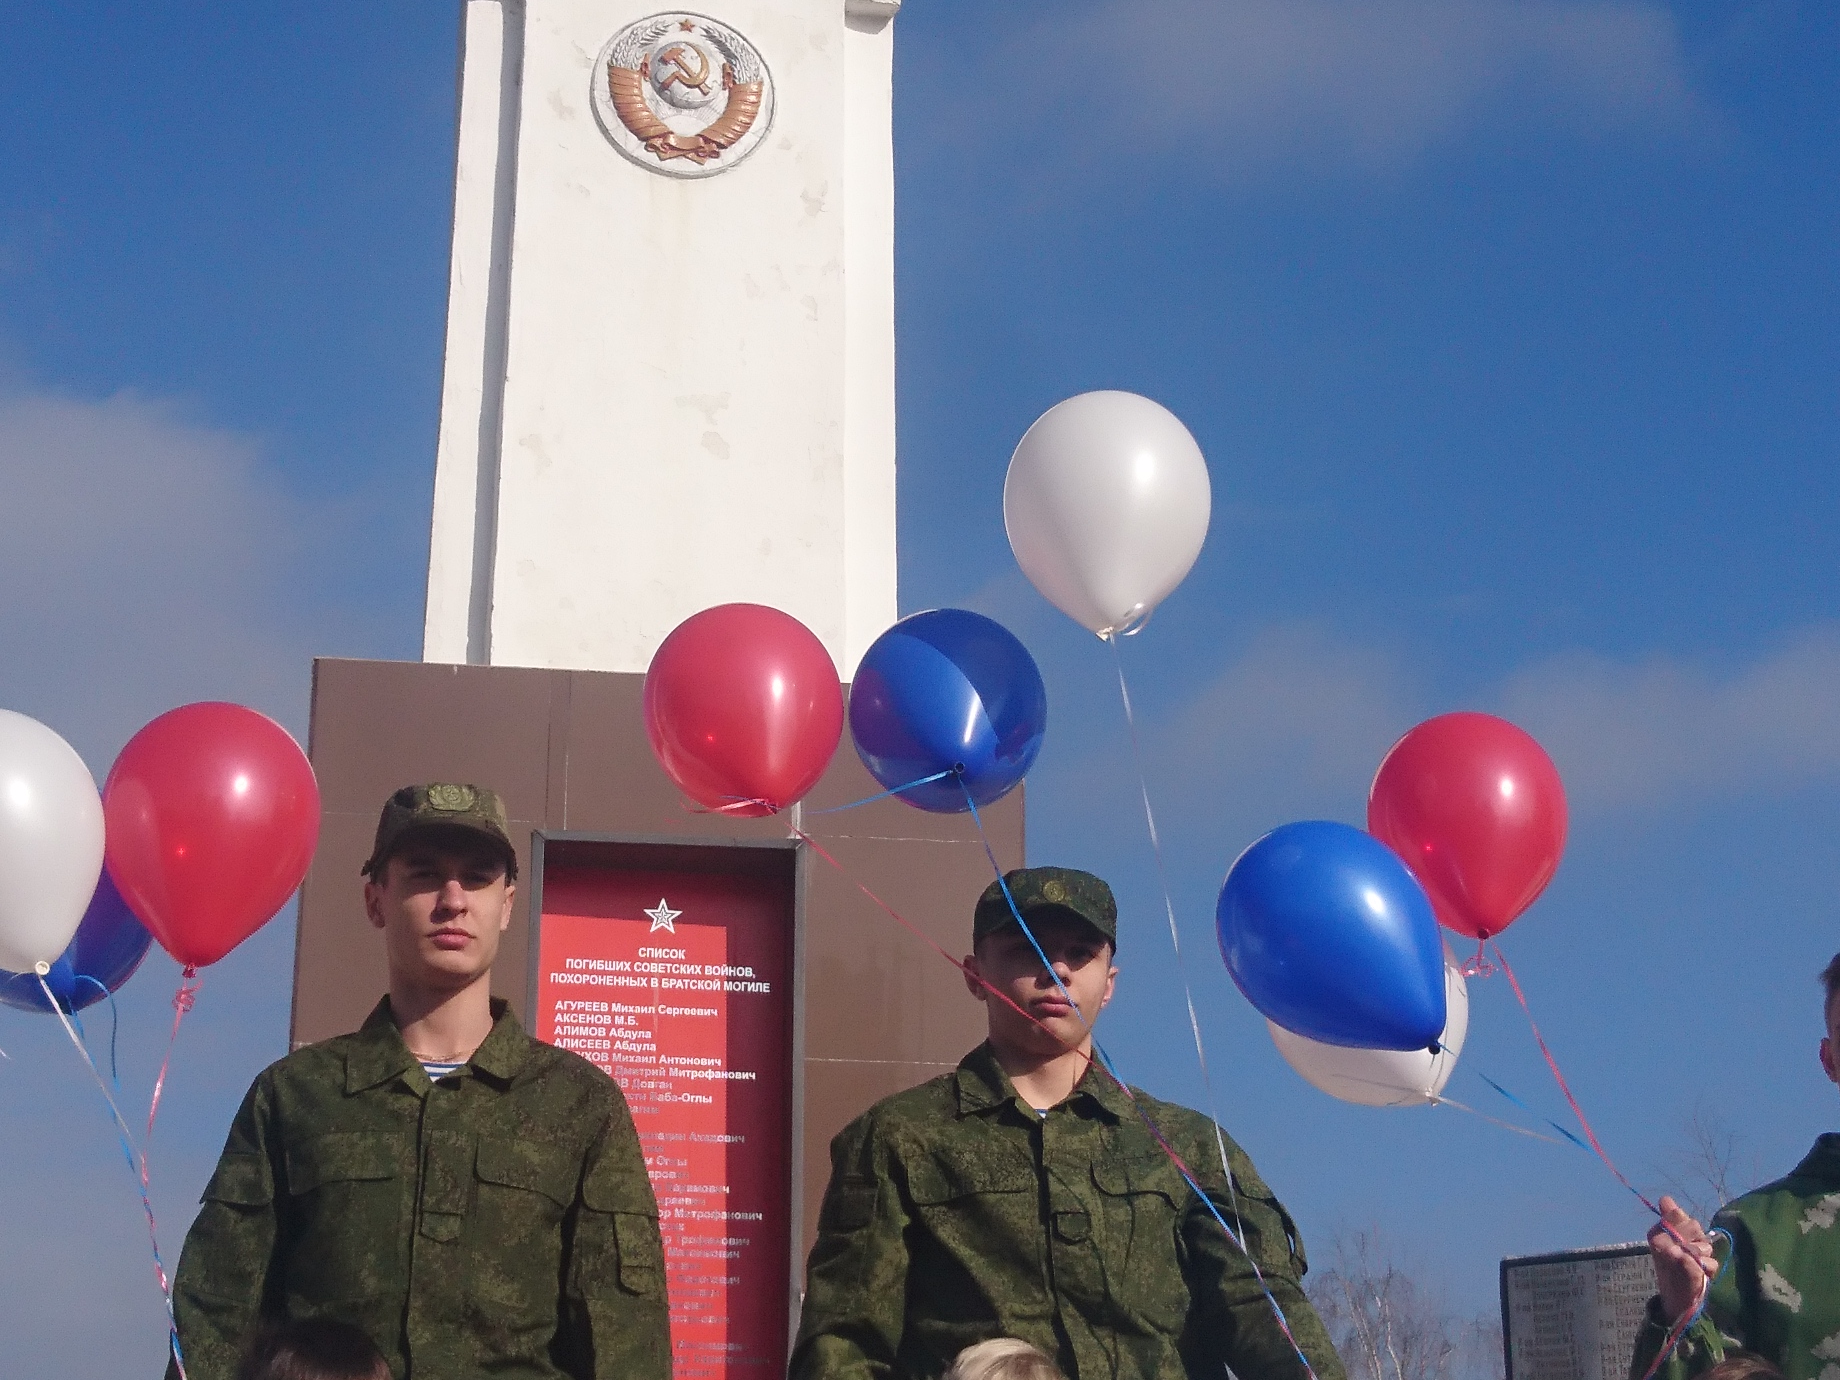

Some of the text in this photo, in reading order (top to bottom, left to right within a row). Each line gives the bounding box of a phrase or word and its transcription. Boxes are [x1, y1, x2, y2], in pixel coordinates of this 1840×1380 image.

[638, 947, 686, 960] СПИСОК
[565, 958, 632, 972] ПОГИБШИХ
[633, 961, 702, 975] СОВЕТСКИХ
[550, 972, 771, 993] ПОХОРОНЕННЫХ В БРАТСКОЙ МОГИЛЕ
[554, 1000, 718, 1017] АГУРЕЕВ Михаил Сергеевич
[554, 1012, 639, 1026] АКСЕНОВ М.Б.
[553, 1025, 652, 1040] АЛИМОВ Абдула
[553, 1037, 657, 1052] АЛИСЕЕВ Абдула
[612, 1052, 657, 1064] Михаил
[658, 1054, 722, 1067] Антонович
[668, 1066, 756, 1082] Митрофанович
